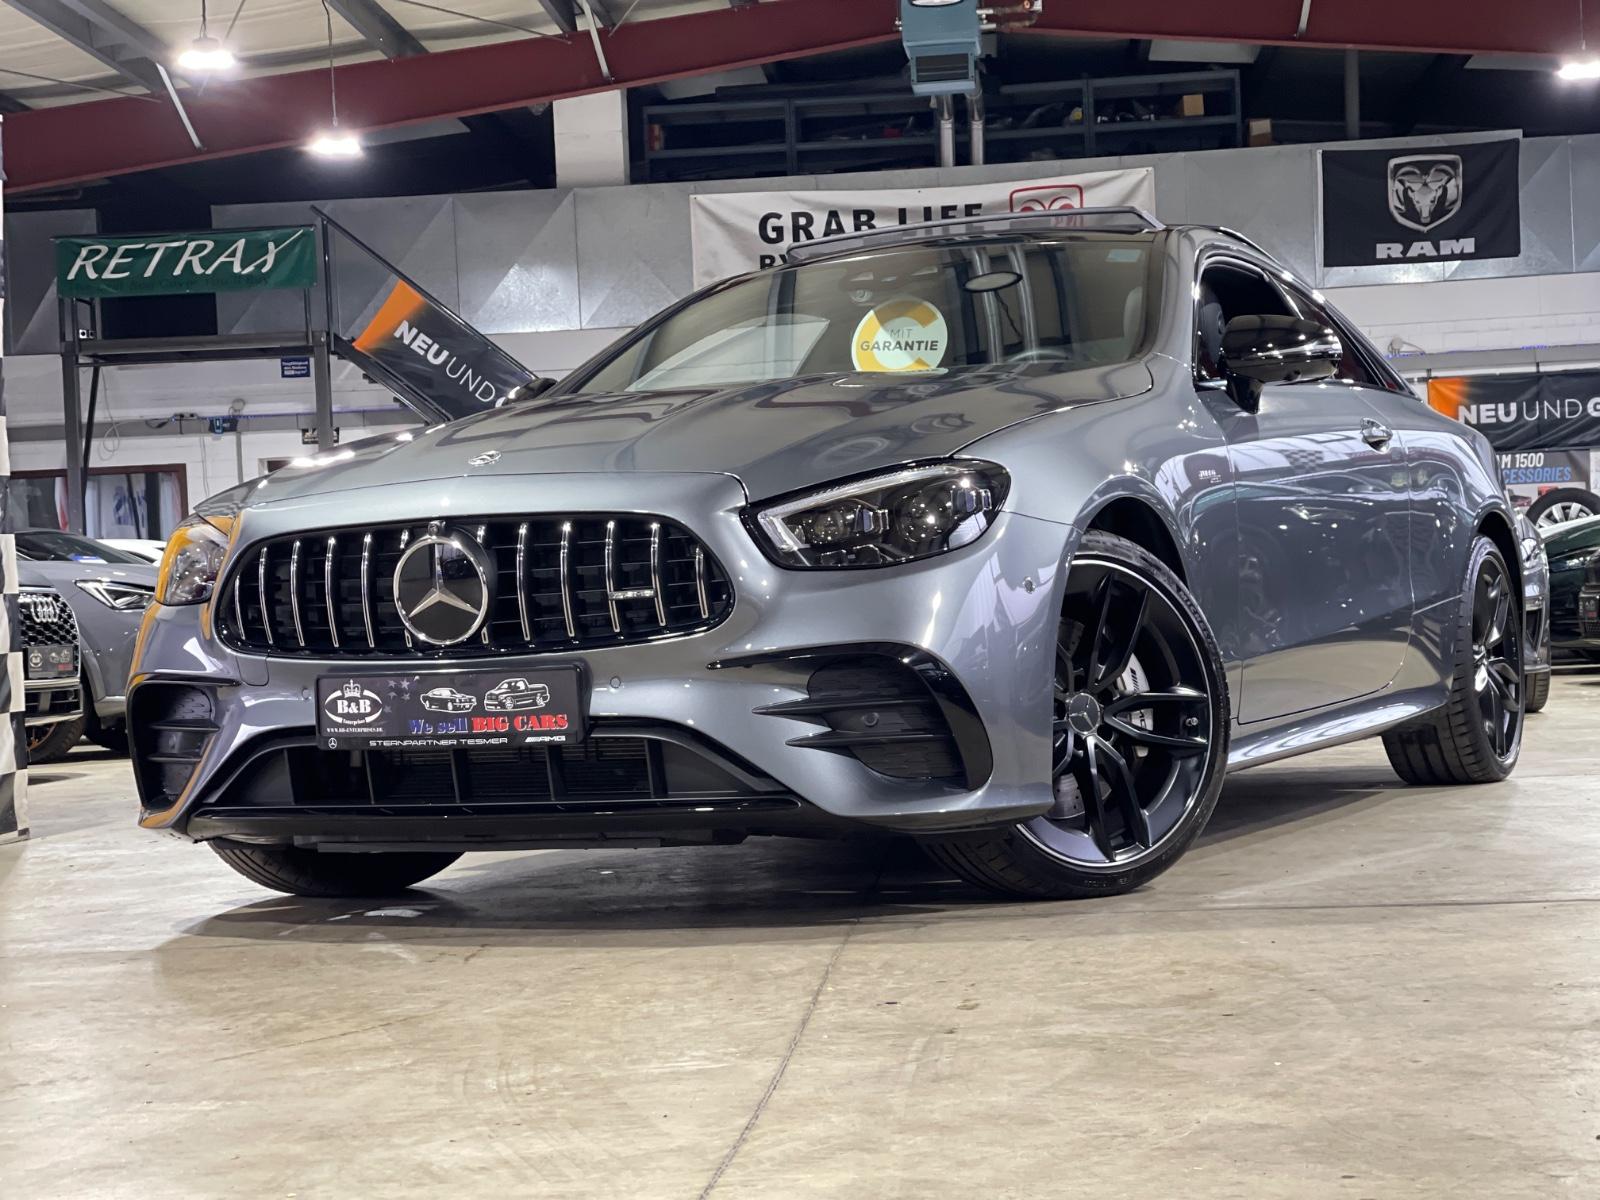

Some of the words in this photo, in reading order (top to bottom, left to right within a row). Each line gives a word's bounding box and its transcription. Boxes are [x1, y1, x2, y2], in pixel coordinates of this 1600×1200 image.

[758, 209, 876, 244] GRAB
[66, 229, 304, 281] RETRAX
[1376, 237, 1476, 259] RAM
[891, 328, 913, 338] MIT
[860, 339, 939, 353] GARANTIE
[393, 319, 450, 365] NEU
[445, 356, 496, 402] UND
[1458, 402, 1518, 425] NEU
[1523, 398, 1583, 421] UND
[1515, 452, 1545, 468] 1500
[336, 699, 372, 714] B&B
[408, 719, 434, 735] We
[437, 717, 469, 734] sell
[472, 717, 510, 734] BIG
[513, 714, 569, 732] CARS
[369, 738, 457, 748] STERNPARTNER
[459, 736, 508, 746] TESMER
[534, 735, 566, 743] AMG
